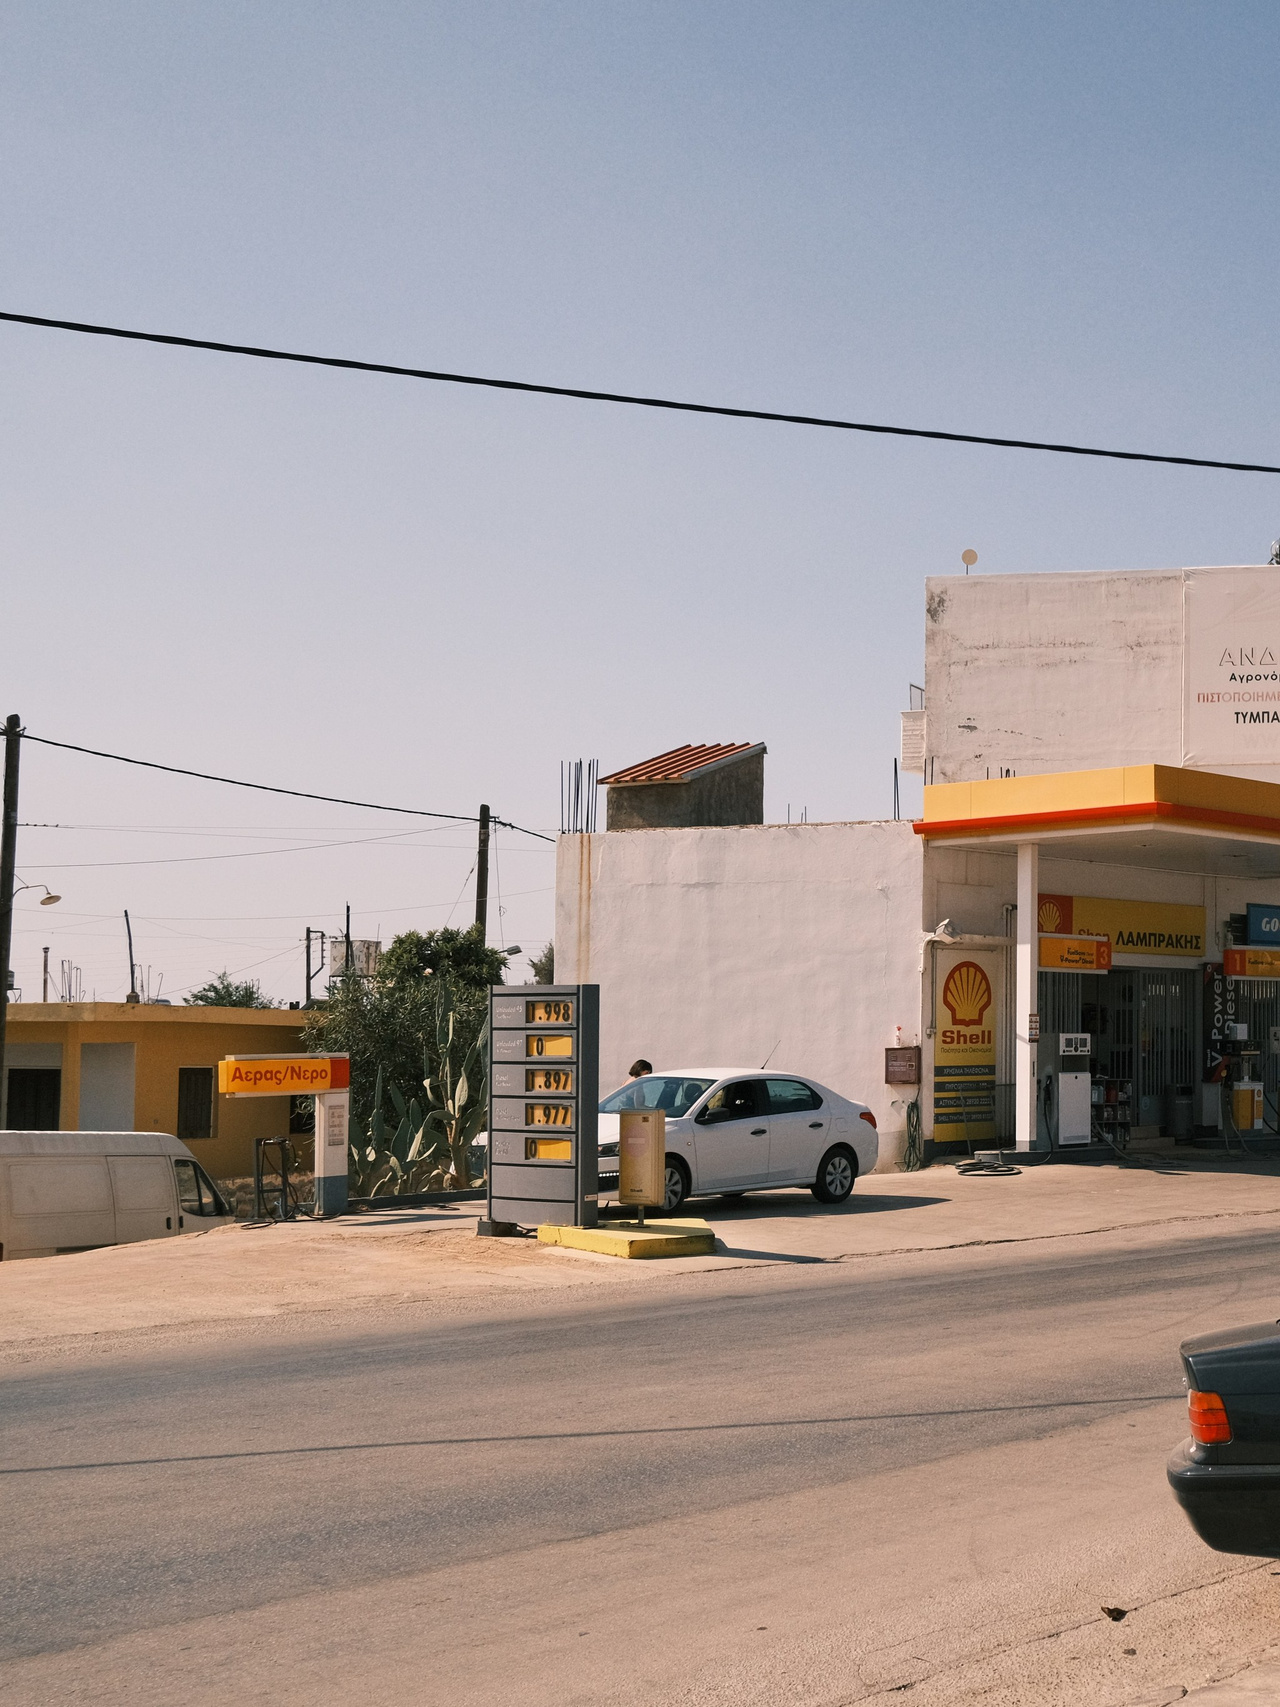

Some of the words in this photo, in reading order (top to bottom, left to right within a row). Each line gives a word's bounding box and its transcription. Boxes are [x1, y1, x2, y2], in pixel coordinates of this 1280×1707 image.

[1116, 931, 1200, 949] ΛΑΜΠΡΑΚΗΣ
[1100, 947, 1108, 964] 3
[1234, 954, 1241, 971] 1
[530, 1003, 570, 1022] 1.998
[1225, 976, 1235, 1034] Diese
[942, 1030, 991, 1044] Shell
[231, 1066, 328, 1085] Αερας/Νερο
[530, 1071, 570, 1090] 1.897
[530, 1105, 570, 1125] 1.977
